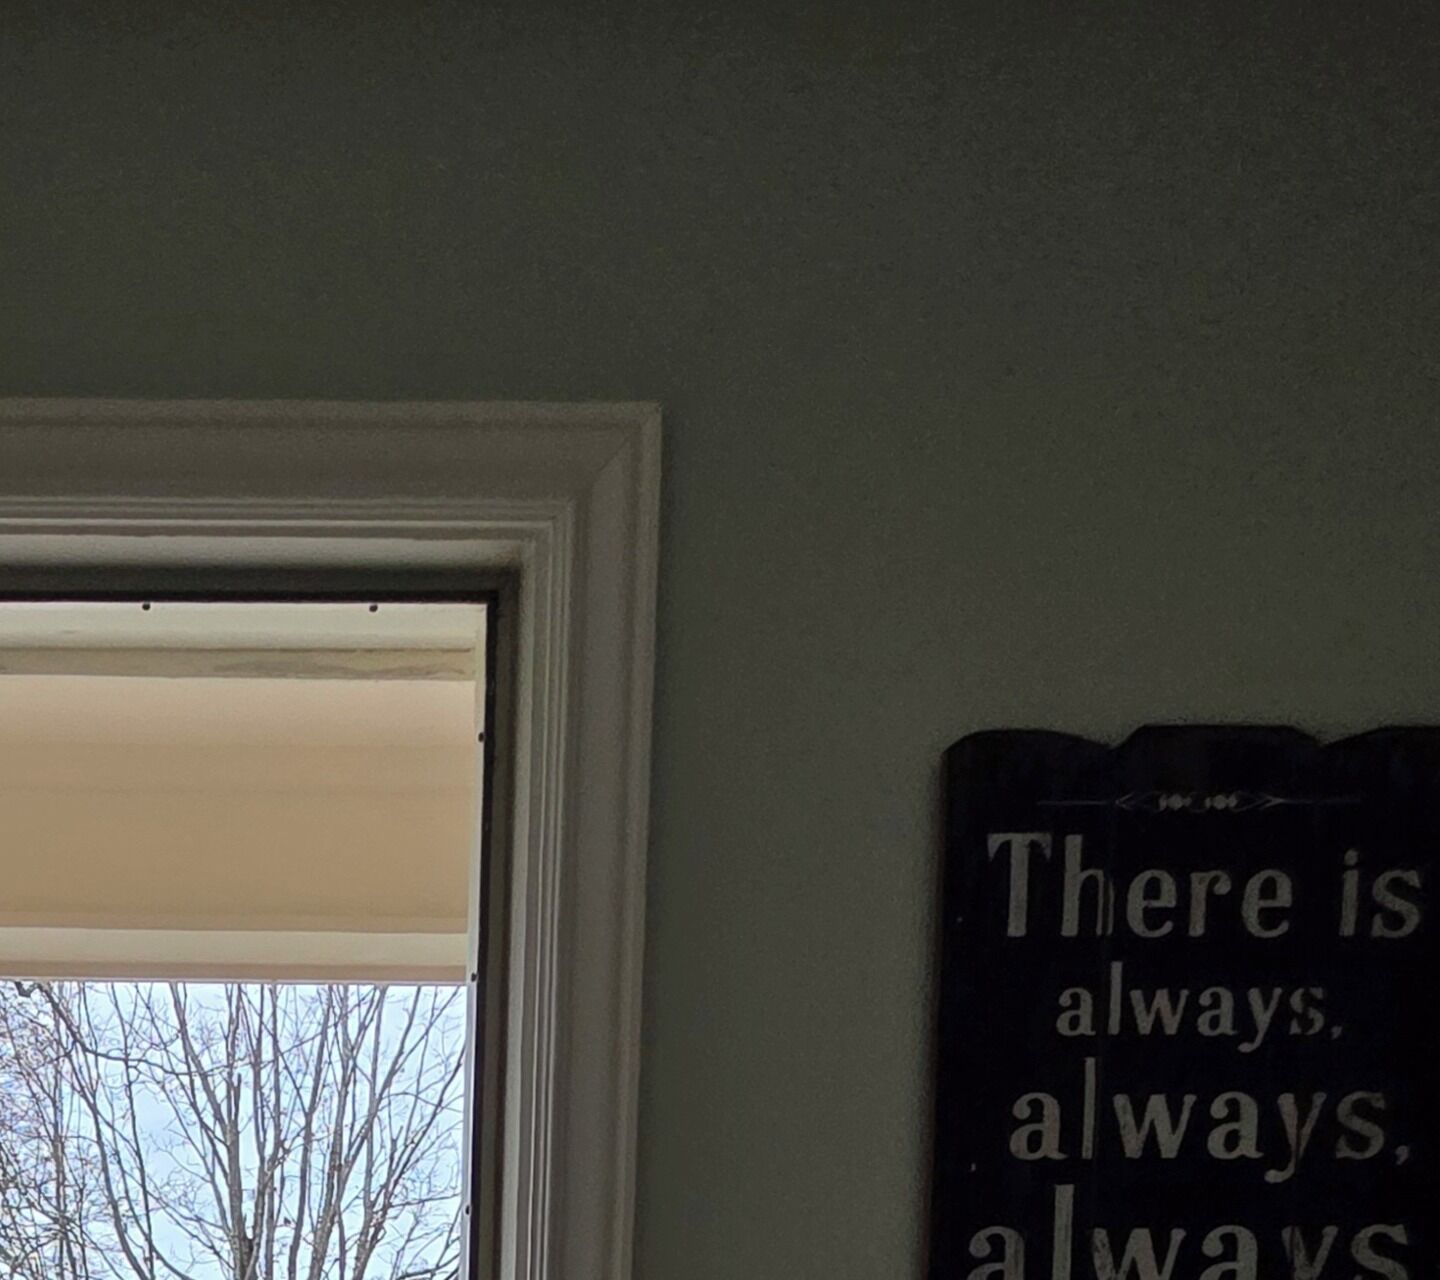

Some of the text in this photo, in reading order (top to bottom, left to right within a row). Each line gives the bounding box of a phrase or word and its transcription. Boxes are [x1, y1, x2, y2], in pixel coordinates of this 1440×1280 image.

[986, 832, 1422, 939] There is
[1055, 960, 1343, 1053] always,
[1008, 1056, 1410, 1184] always,
